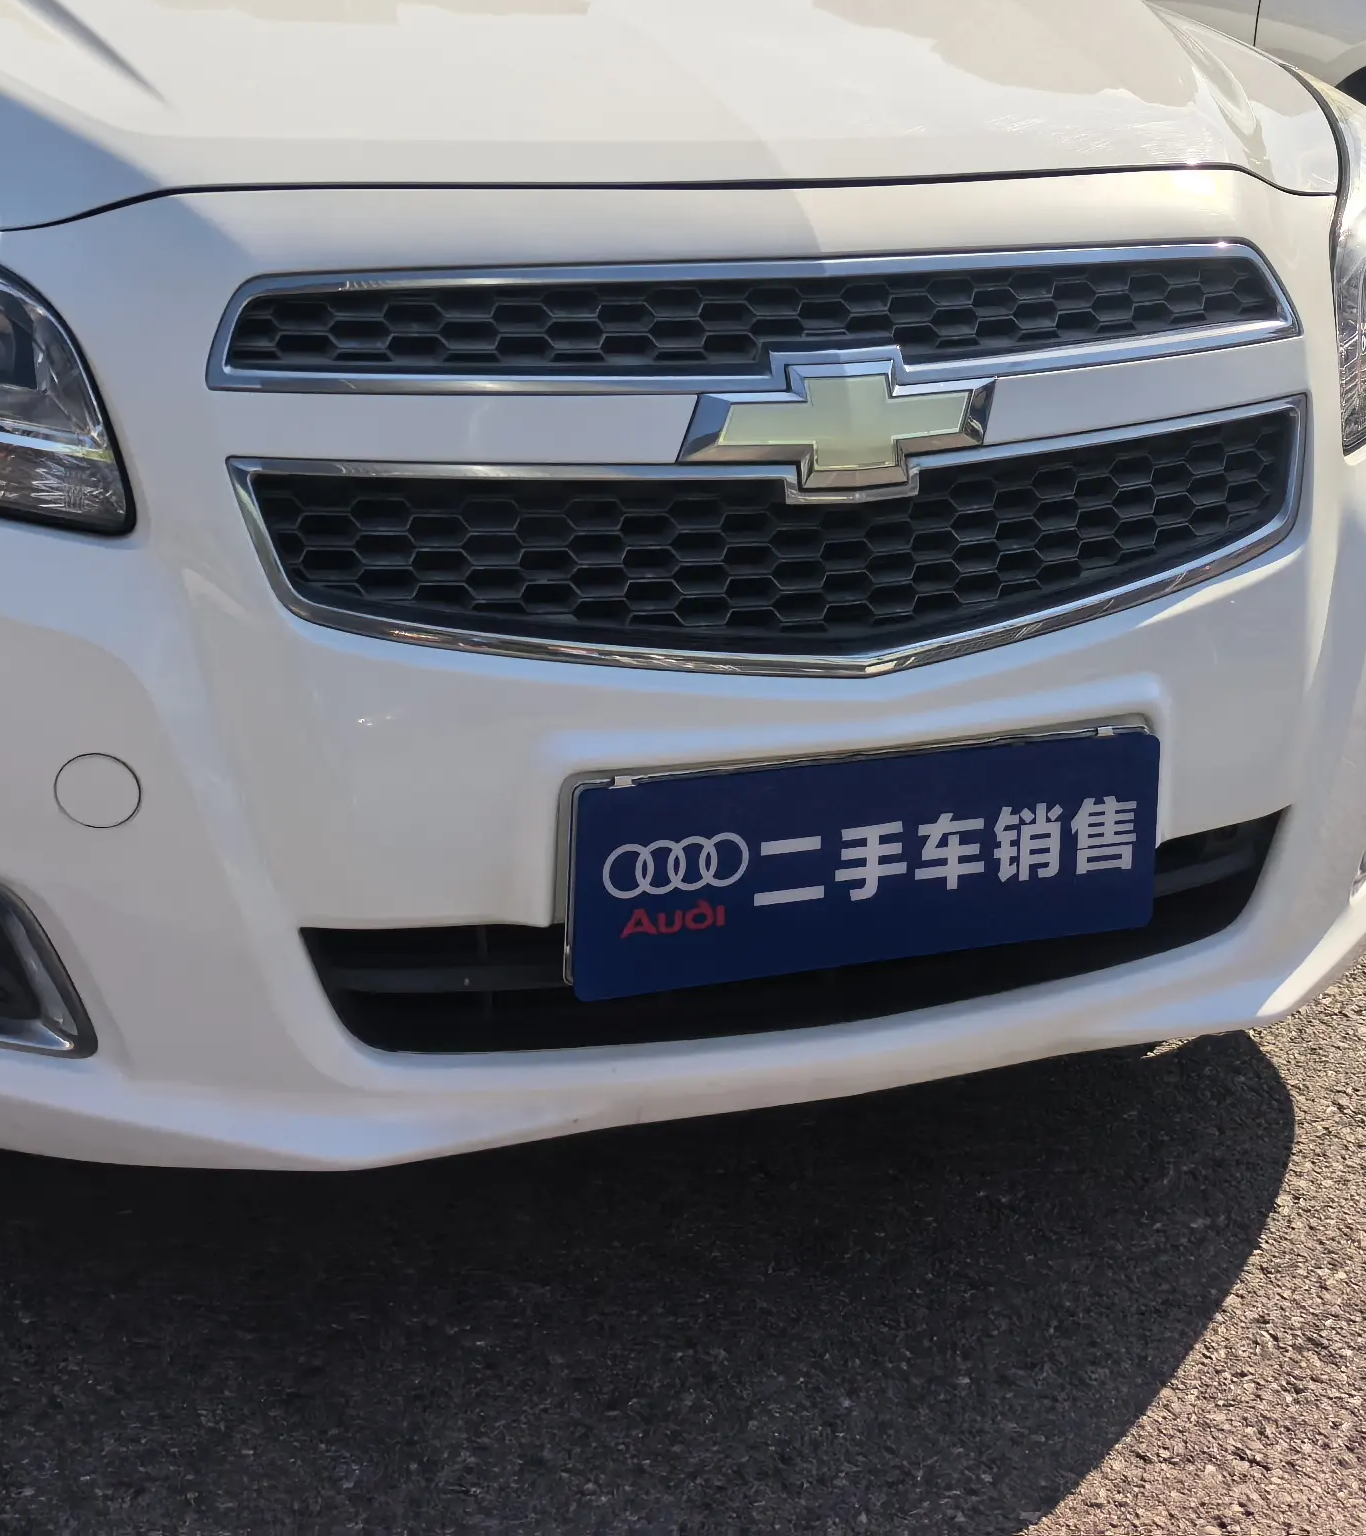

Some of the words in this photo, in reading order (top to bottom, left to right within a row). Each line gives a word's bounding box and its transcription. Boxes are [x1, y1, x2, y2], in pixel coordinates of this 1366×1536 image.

[753, 795, 1138, 907] 二手车销售
[619, 899, 726, 939] Audi
